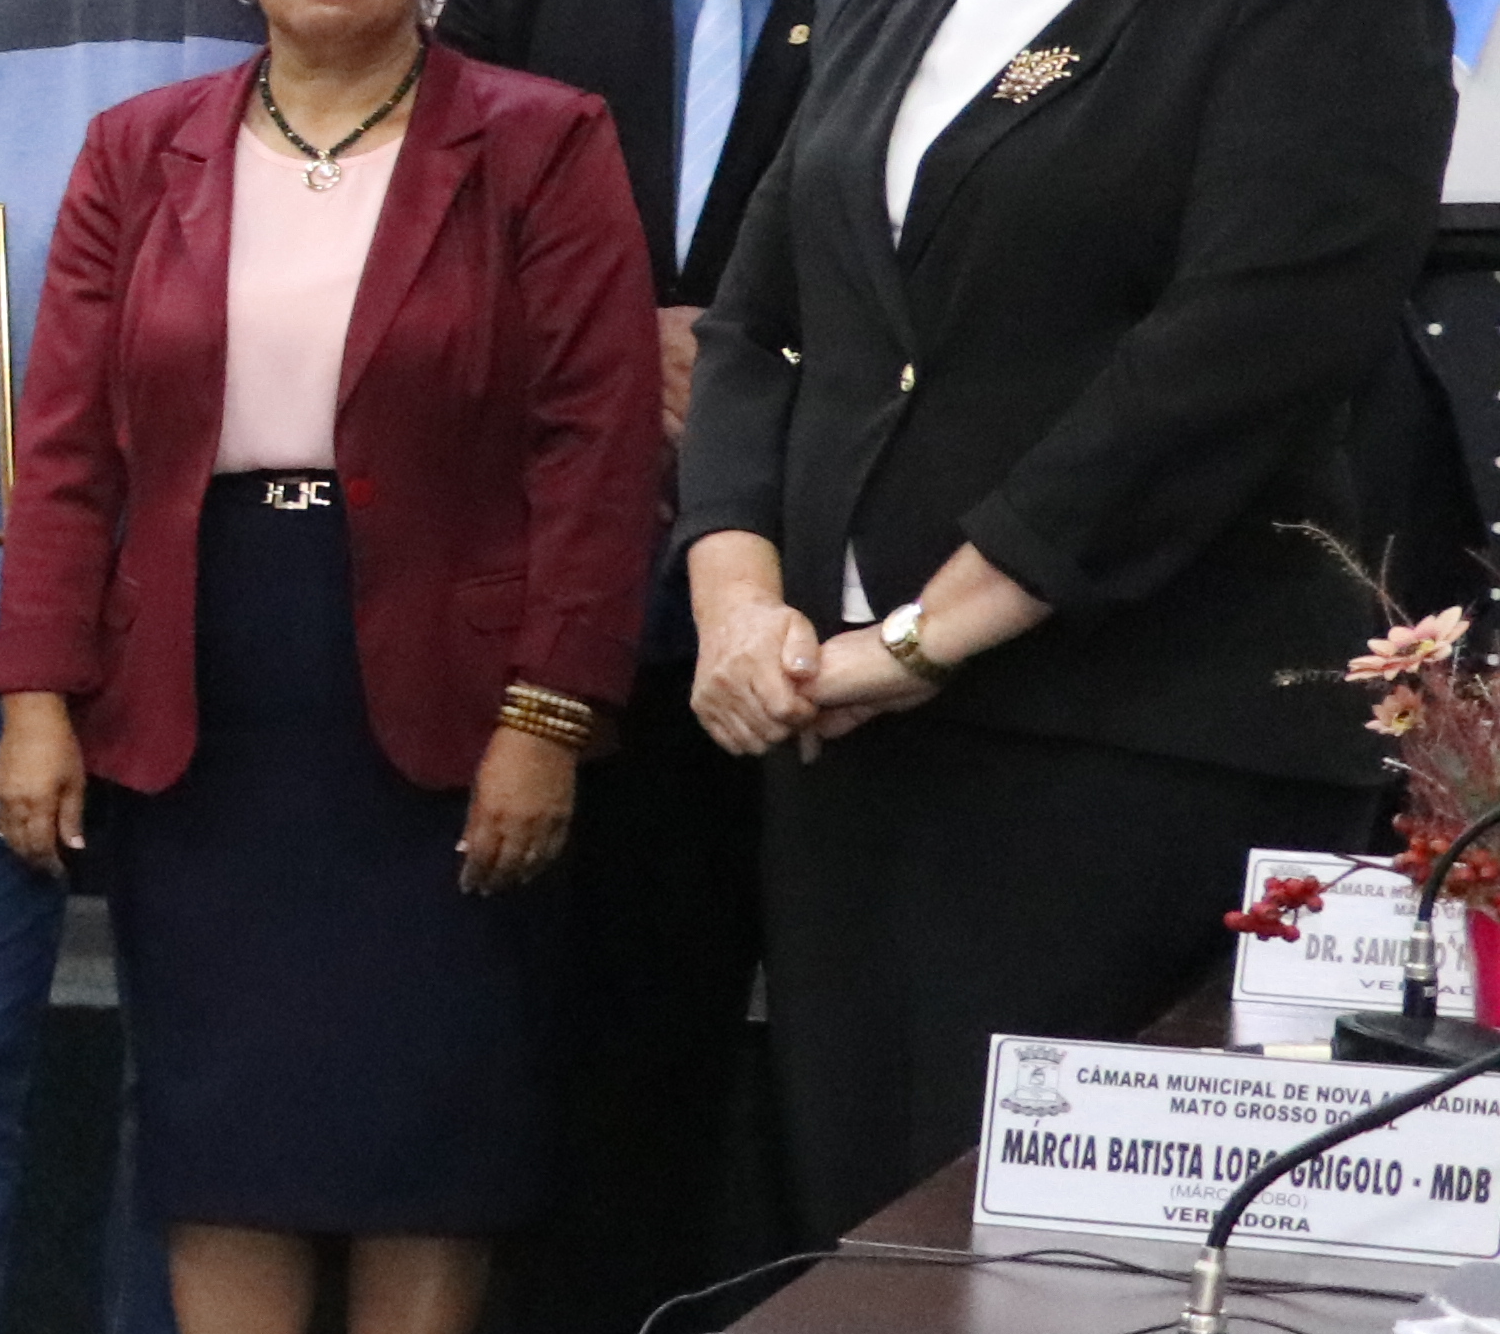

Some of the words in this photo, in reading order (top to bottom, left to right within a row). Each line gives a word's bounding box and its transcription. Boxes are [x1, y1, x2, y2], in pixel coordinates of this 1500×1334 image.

[1305, 933, 1343, 963] DR.
[1353, 936, 1446, 968] SANDO
[1077, 1065, 1159, 1090] CÂMARA
[1166, 1074, 1276, 1099] MUNICIPAL
[1283, 1083, 1309, 1101] DE
[1316, 1087, 1372, 1106] NOVA
[1381, 1091, 1500, 1116] ARADINA
[1170, 1097, 1226, 1116] MATO
[1234, 1102, 1317, 1124] GROSSO
[1001, 1119, 1097, 1171] MÁRCIA
[1107, 1137, 1202, 1180] BATISTA
[1430, 1164, 1492, 1203] MDB
[1170, 1181, 1231, 1204] (MÁRC
[1163, 1206, 1310, 1232] VERDORA
